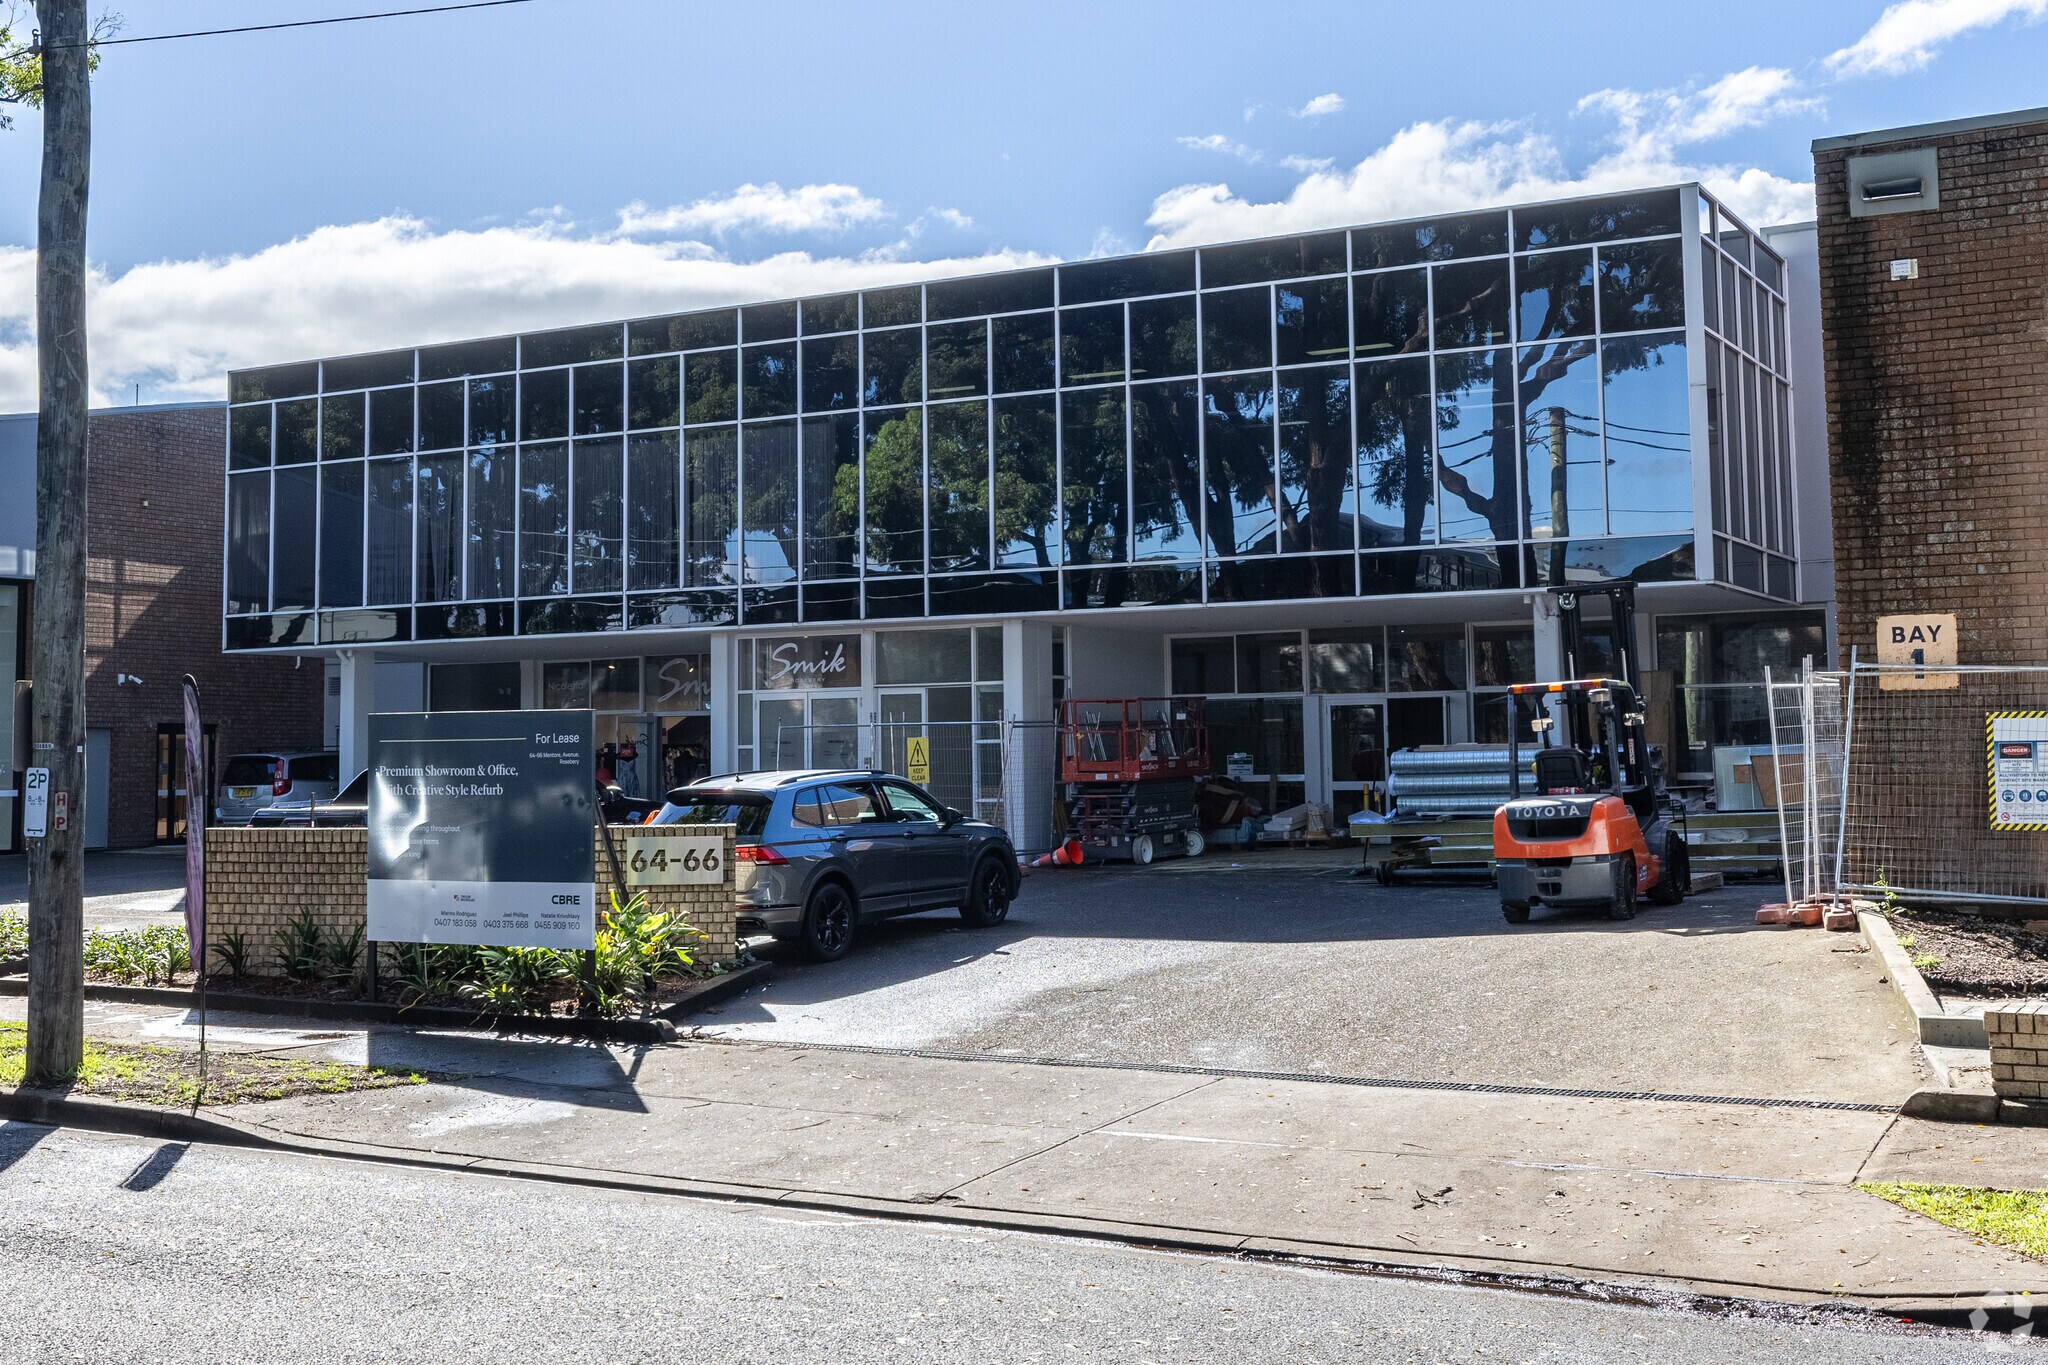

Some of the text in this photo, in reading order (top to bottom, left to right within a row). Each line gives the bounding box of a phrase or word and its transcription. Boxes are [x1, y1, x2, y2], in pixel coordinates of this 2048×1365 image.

[1891, 625, 1942, 643] BAY
[770, 642, 846, 680] Smik
[1911, 649, 1924, 679] 1
[657, 658, 711, 702] Sm
[535, 733, 580, 744] For Lease
[380, 763, 519, 777] Premium Showroom & Office,
[28, 772, 48, 789] 2P
[382, 784, 403, 796] ith
[445, 783, 469, 798] Style
[470, 783, 504, 796] Refurb
[1514, 805, 1580, 818] TOYOTA
[430, 825, 461, 834] throughout
[630, 848, 720, 873] 64-66
[551, 895, 580, 905] CBRE
[434, 918, 451, 926] 0407
[464, 919, 477, 928] 058
[483, 919, 529, 929] 0403 375 668
[534, 920, 580, 930] 0455 909 160
